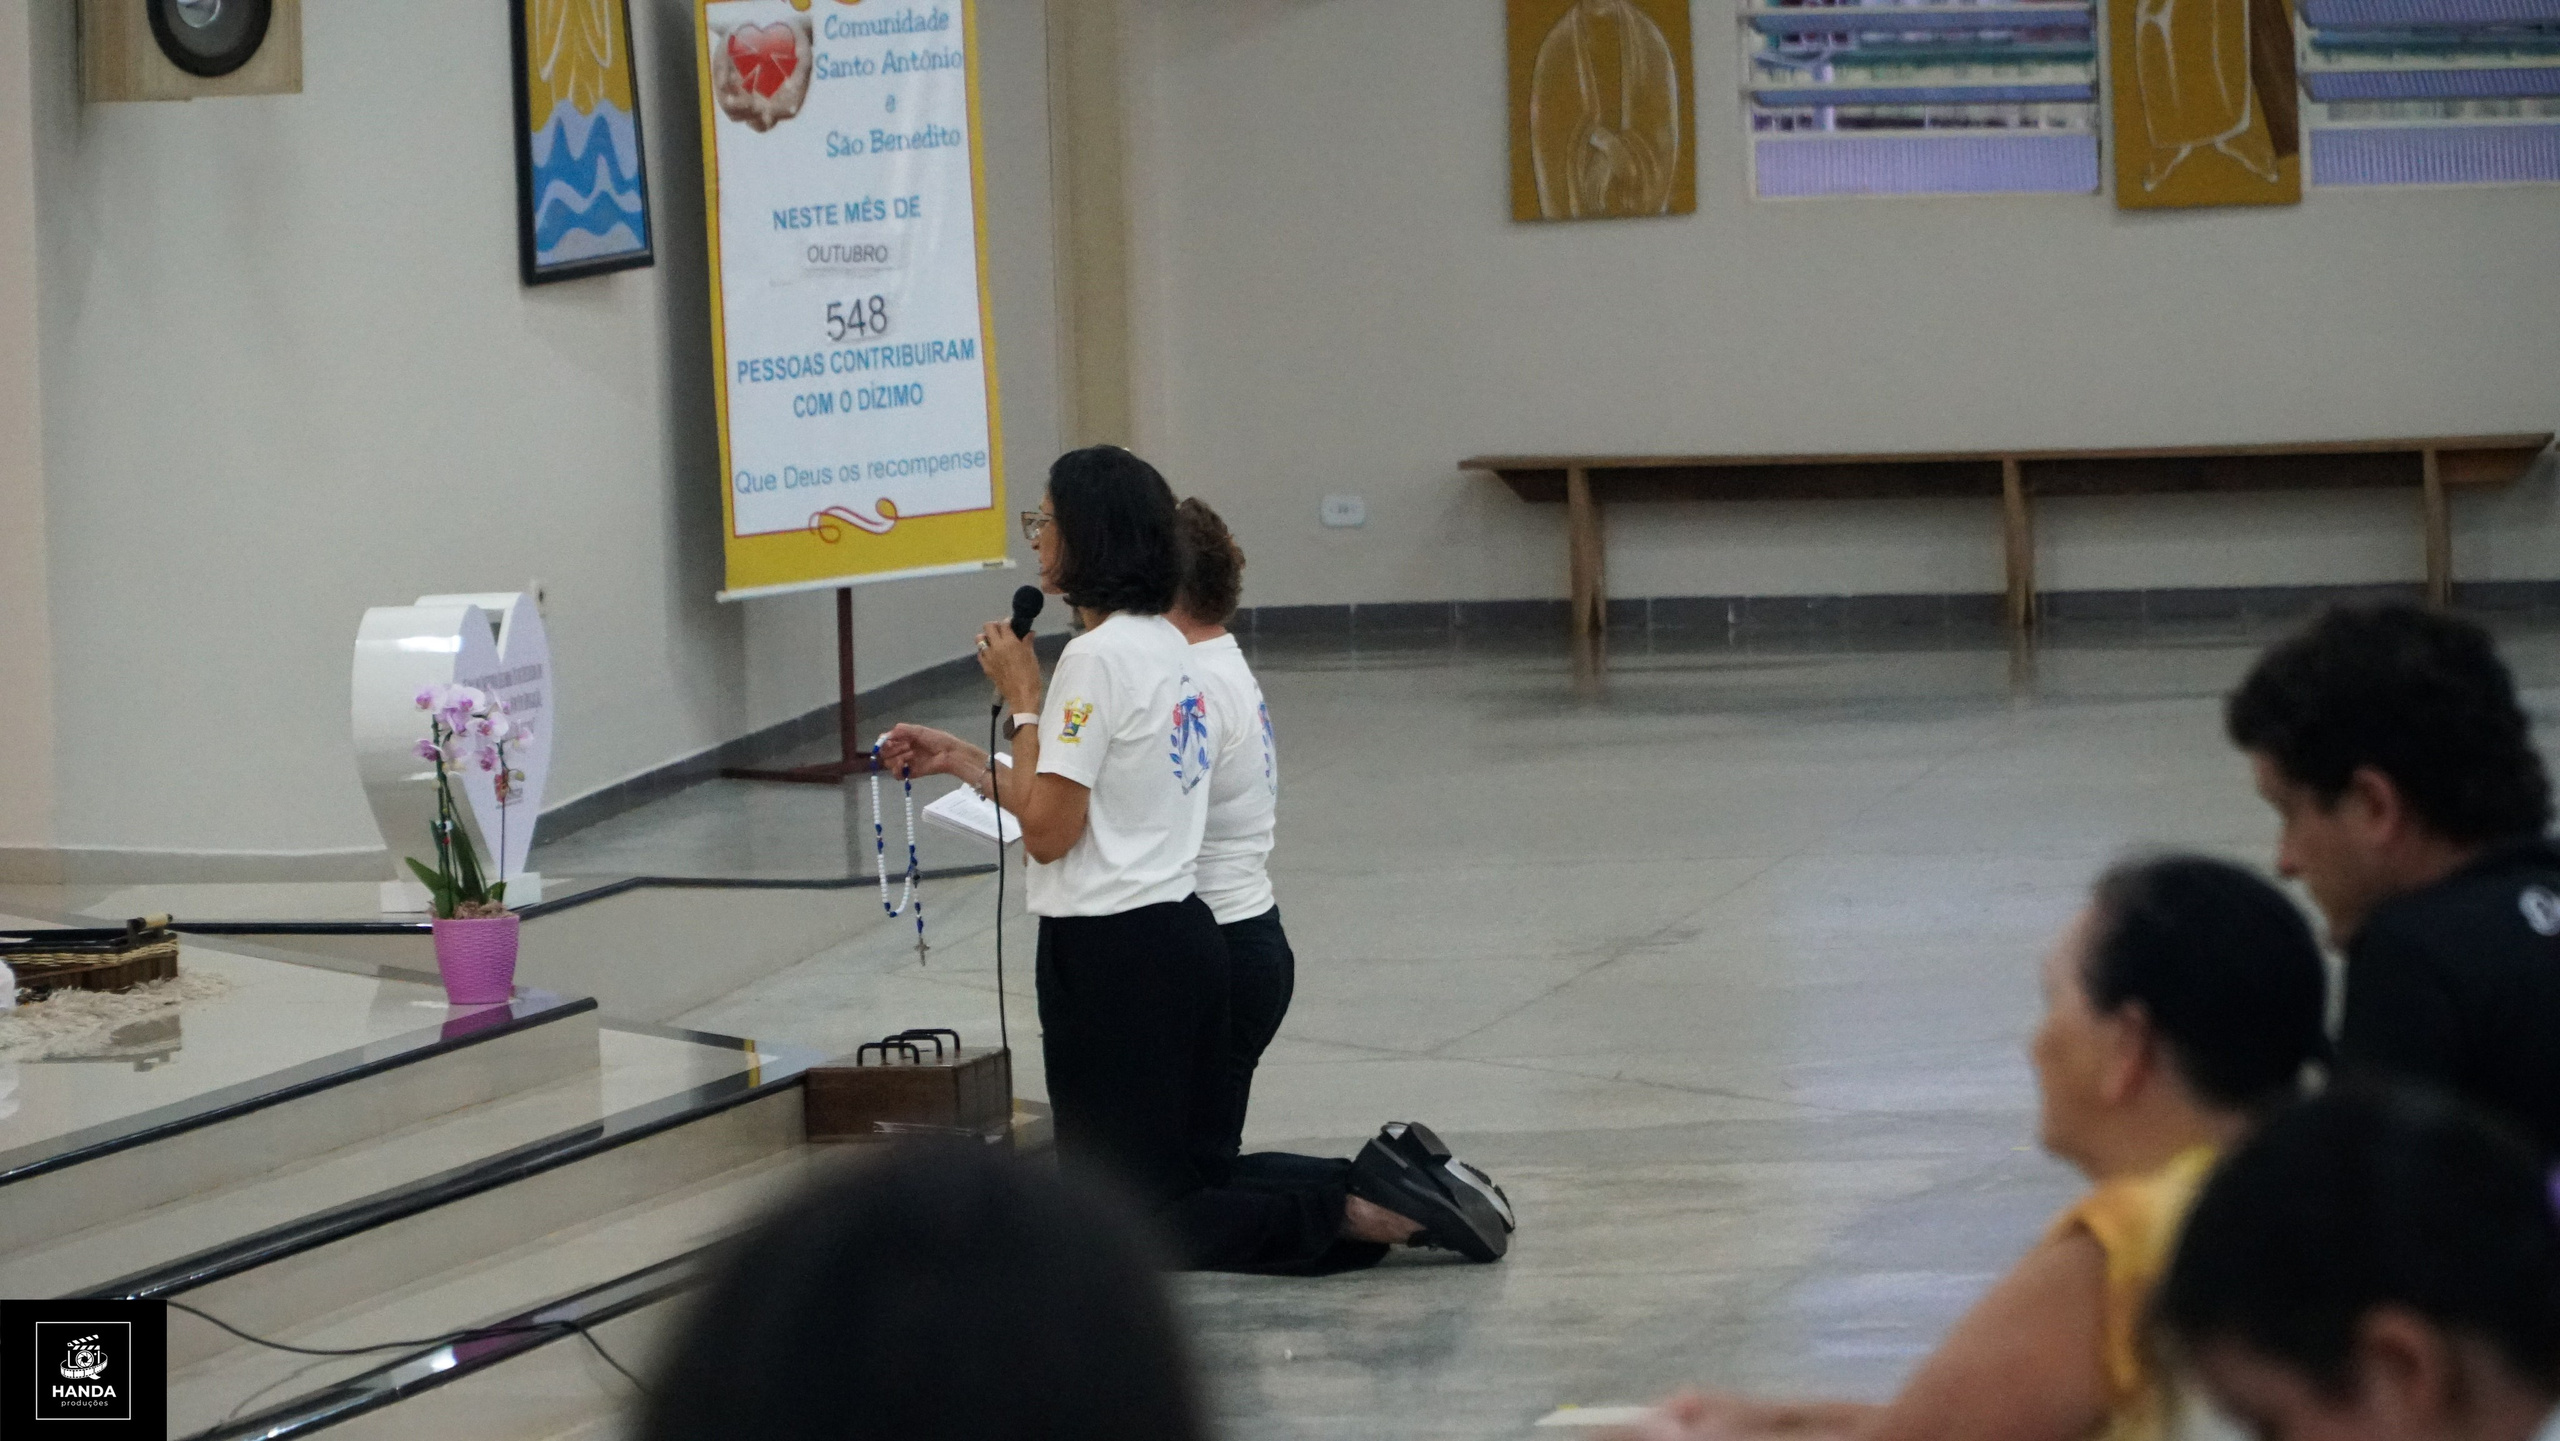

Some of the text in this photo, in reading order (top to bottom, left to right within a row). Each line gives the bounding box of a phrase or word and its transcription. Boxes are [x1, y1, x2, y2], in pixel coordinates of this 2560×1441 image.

[823, 8, 949, 40] Comunidade
[815, 47, 963, 80] Santo Antônio
[869, 124, 961, 154] Benedito
[772, 195, 921, 230] NESTE MÊS DE
[807, 244, 888, 264] OUTUBRO
[826, 294, 888, 342] 548
[737, 337, 976, 384] PESSOAS CONTRIBUIRAM
[793, 381, 923, 418] COM O DÍZIMO
[735, 450, 986, 494] Que Deus os recompense
